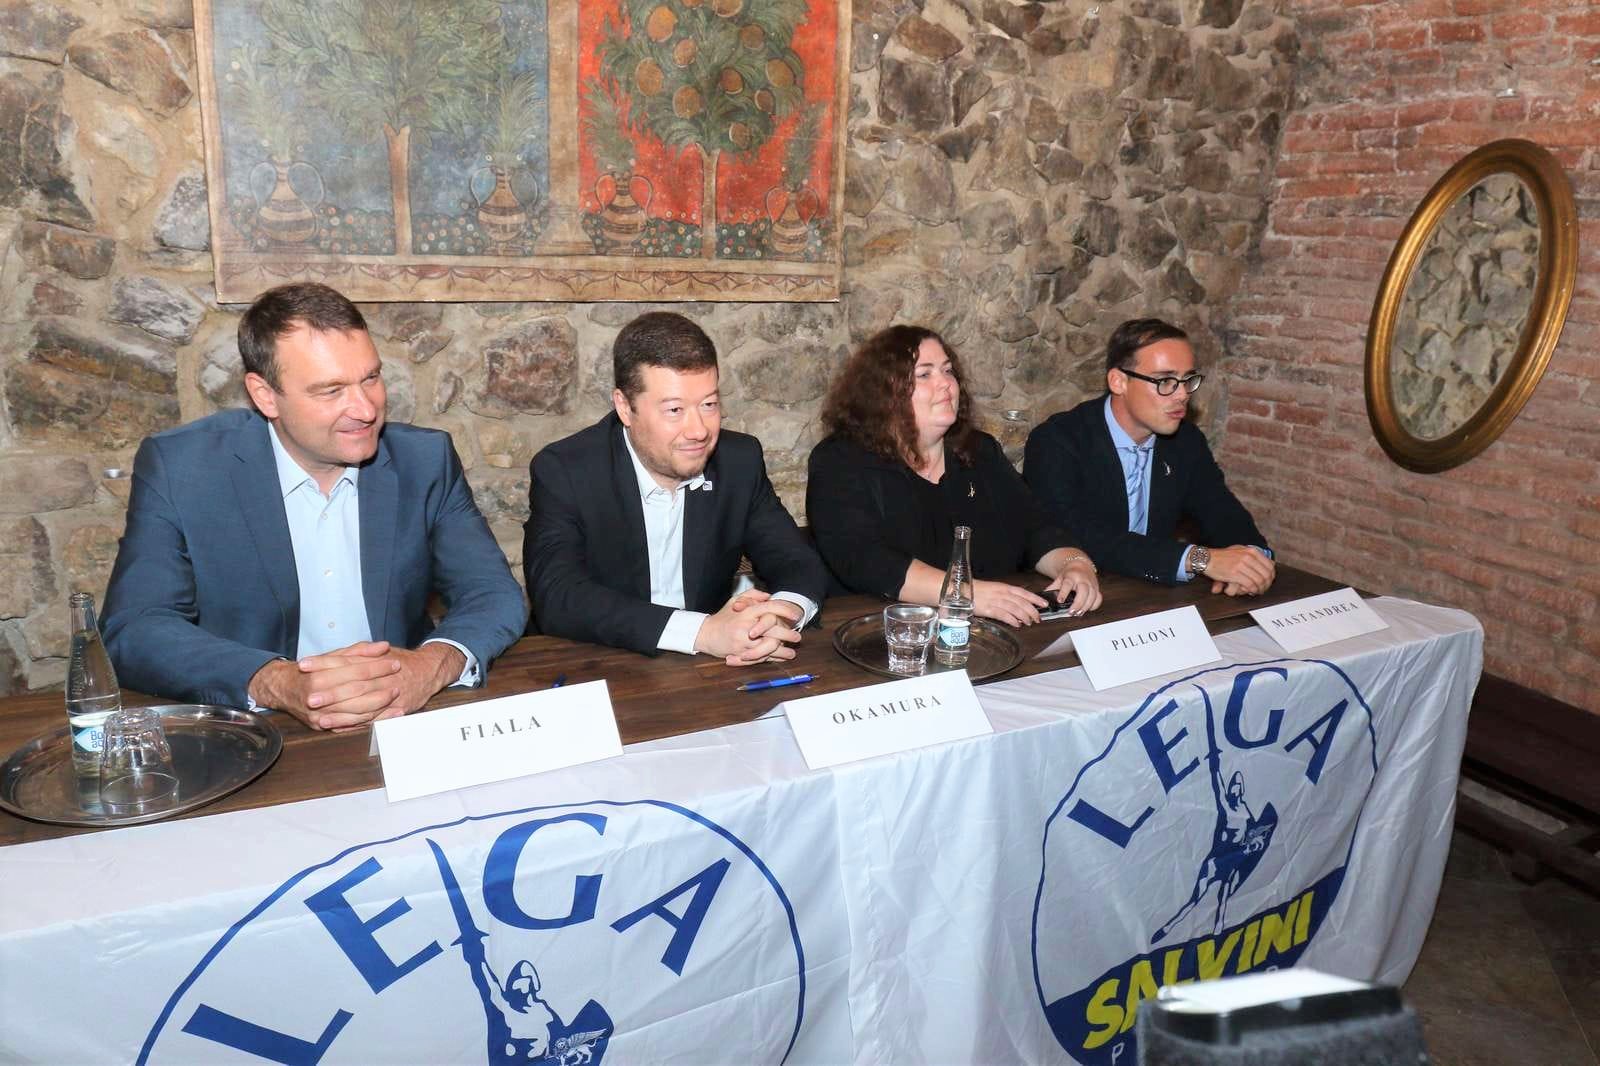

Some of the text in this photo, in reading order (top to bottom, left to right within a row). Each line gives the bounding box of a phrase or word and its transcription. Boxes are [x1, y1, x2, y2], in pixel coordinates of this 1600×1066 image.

[1271, 602, 1359, 628] MASTANDREA
[1111, 627, 1176, 651] PILLONI
[832, 695, 942, 725] OKAMURA
[460, 715, 542, 741] FIALA
[1066, 667, 1350, 850] LEGA
[181, 811, 732, 1066] LEGA
[1082, 890, 1316, 1050] SALVINI
